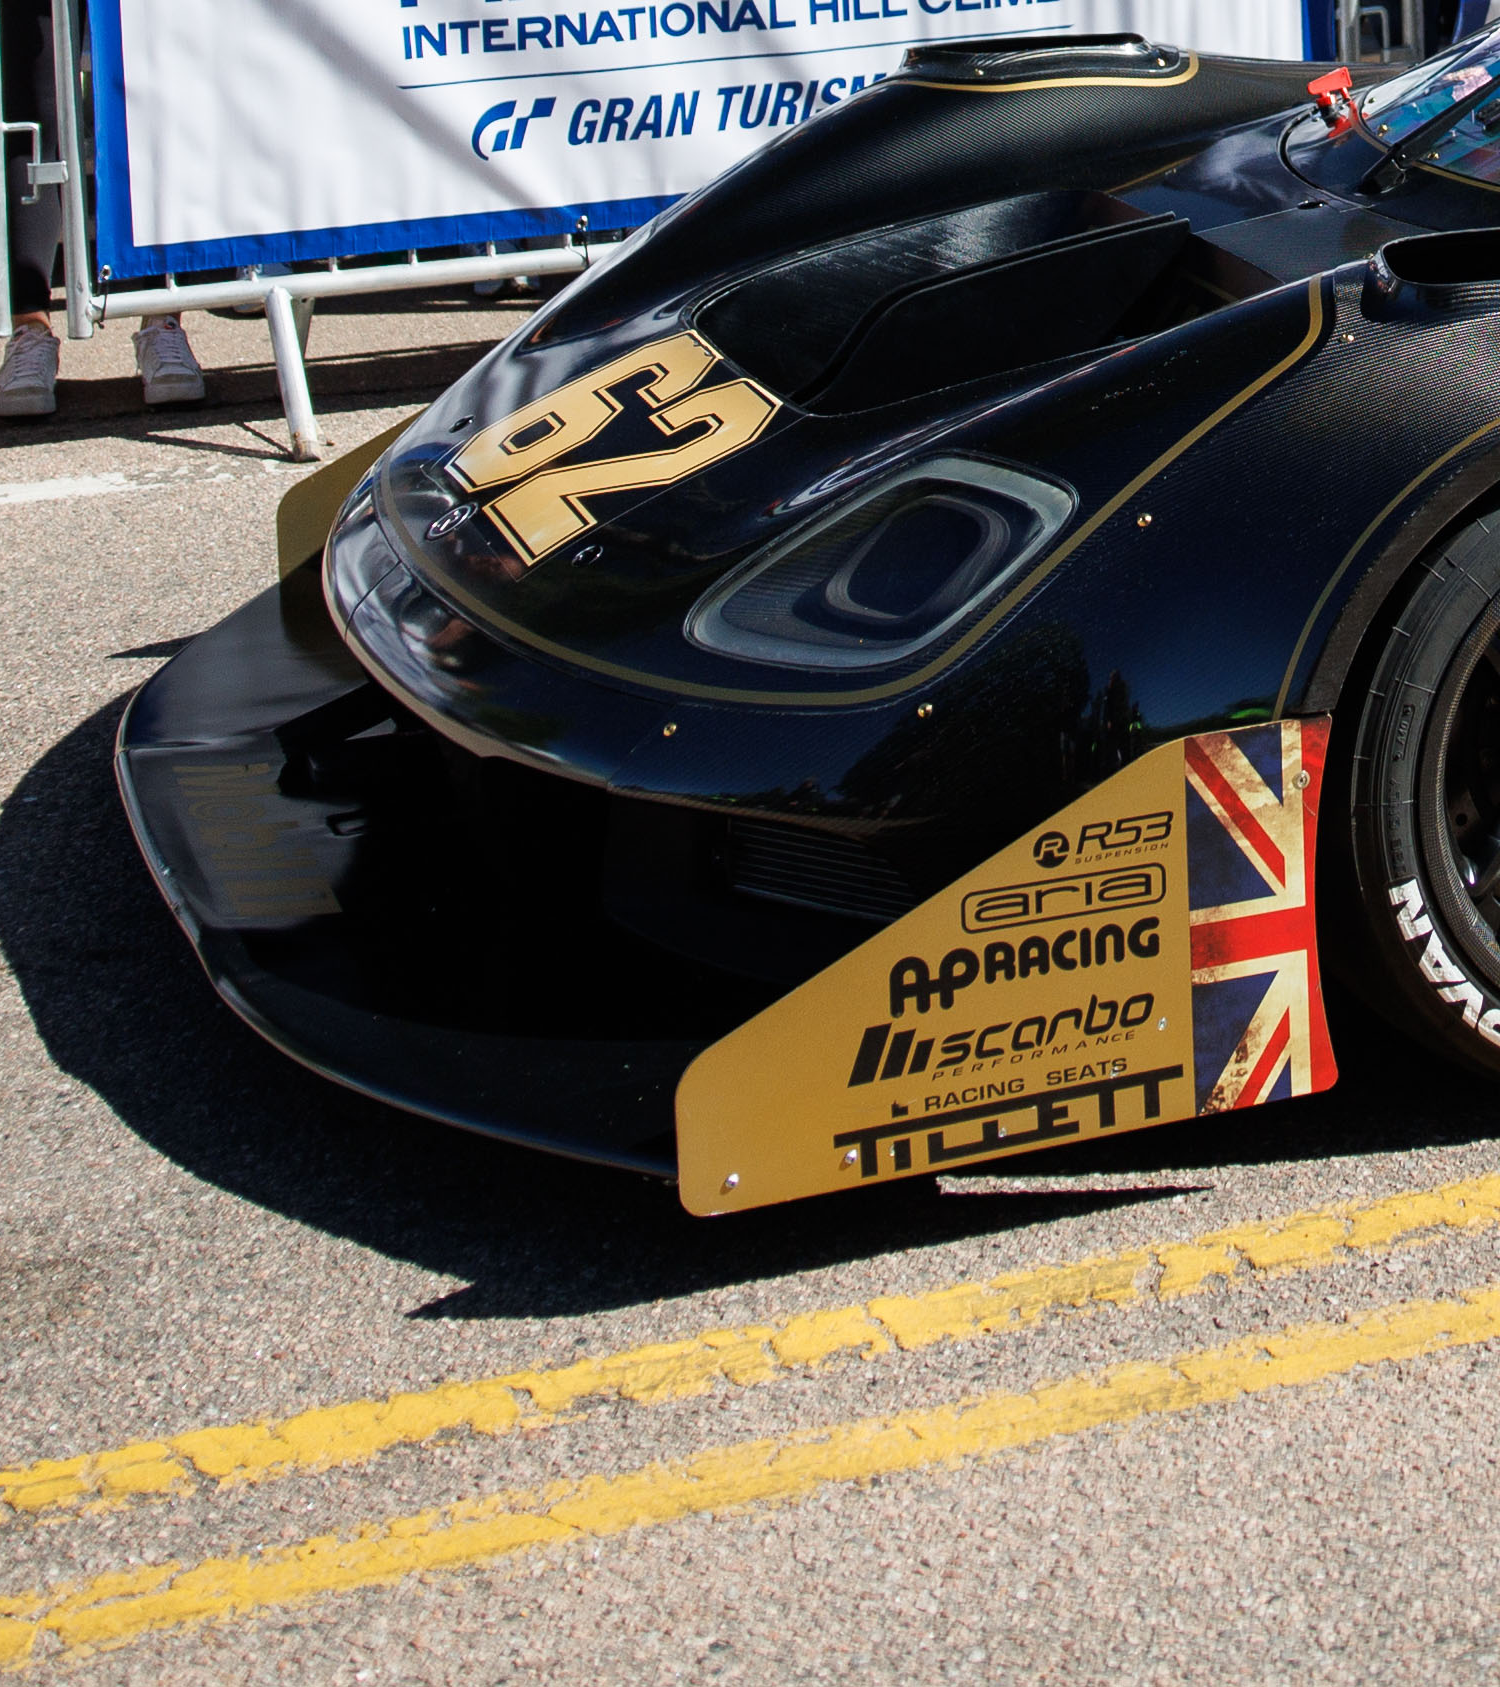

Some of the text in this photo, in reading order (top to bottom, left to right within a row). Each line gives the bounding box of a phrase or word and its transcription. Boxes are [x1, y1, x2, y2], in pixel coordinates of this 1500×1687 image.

[567, 90, 700, 146] GRAN
[444, 328, 783, 567] 62
[1073, 841, 1170, 866] SUSPENSION
[1075, 810, 1173, 855] R53
[974, 872, 1153, 923] aria
[931, 1028, 1137, 1083] PERFORMANCE
[934, 992, 1156, 1070] scarbo
[923, 1056, 1129, 1113] RACING SEATS
[832, 1063, 1184, 1179] TILLETT
